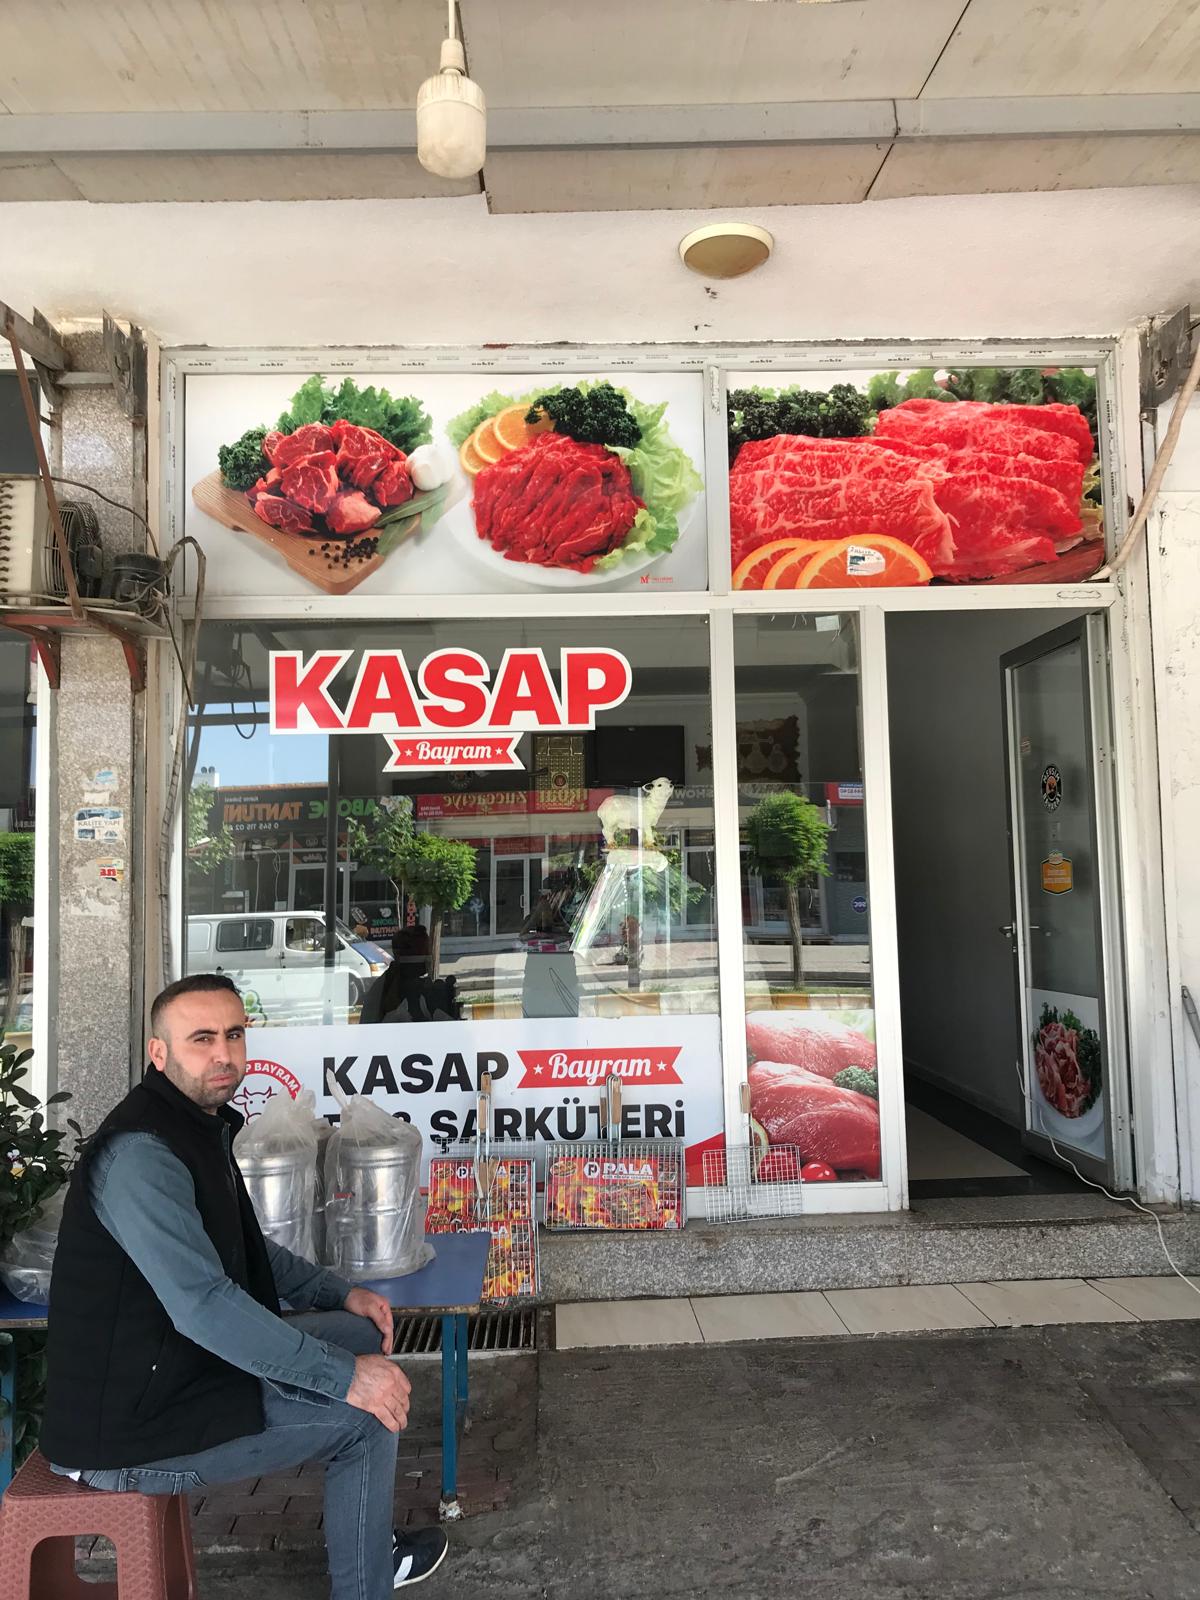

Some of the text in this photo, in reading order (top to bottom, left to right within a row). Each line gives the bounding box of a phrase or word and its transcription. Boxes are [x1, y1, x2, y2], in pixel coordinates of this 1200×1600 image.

[271, 648, 631, 733] KASAP
[416, 741, 492, 765] Bayram
[254, 1063, 299, 1091] BAYRAM
[323, 1052, 652, 1096] KASAP Bayram
[603, 1163, 653, 1175] PALA
